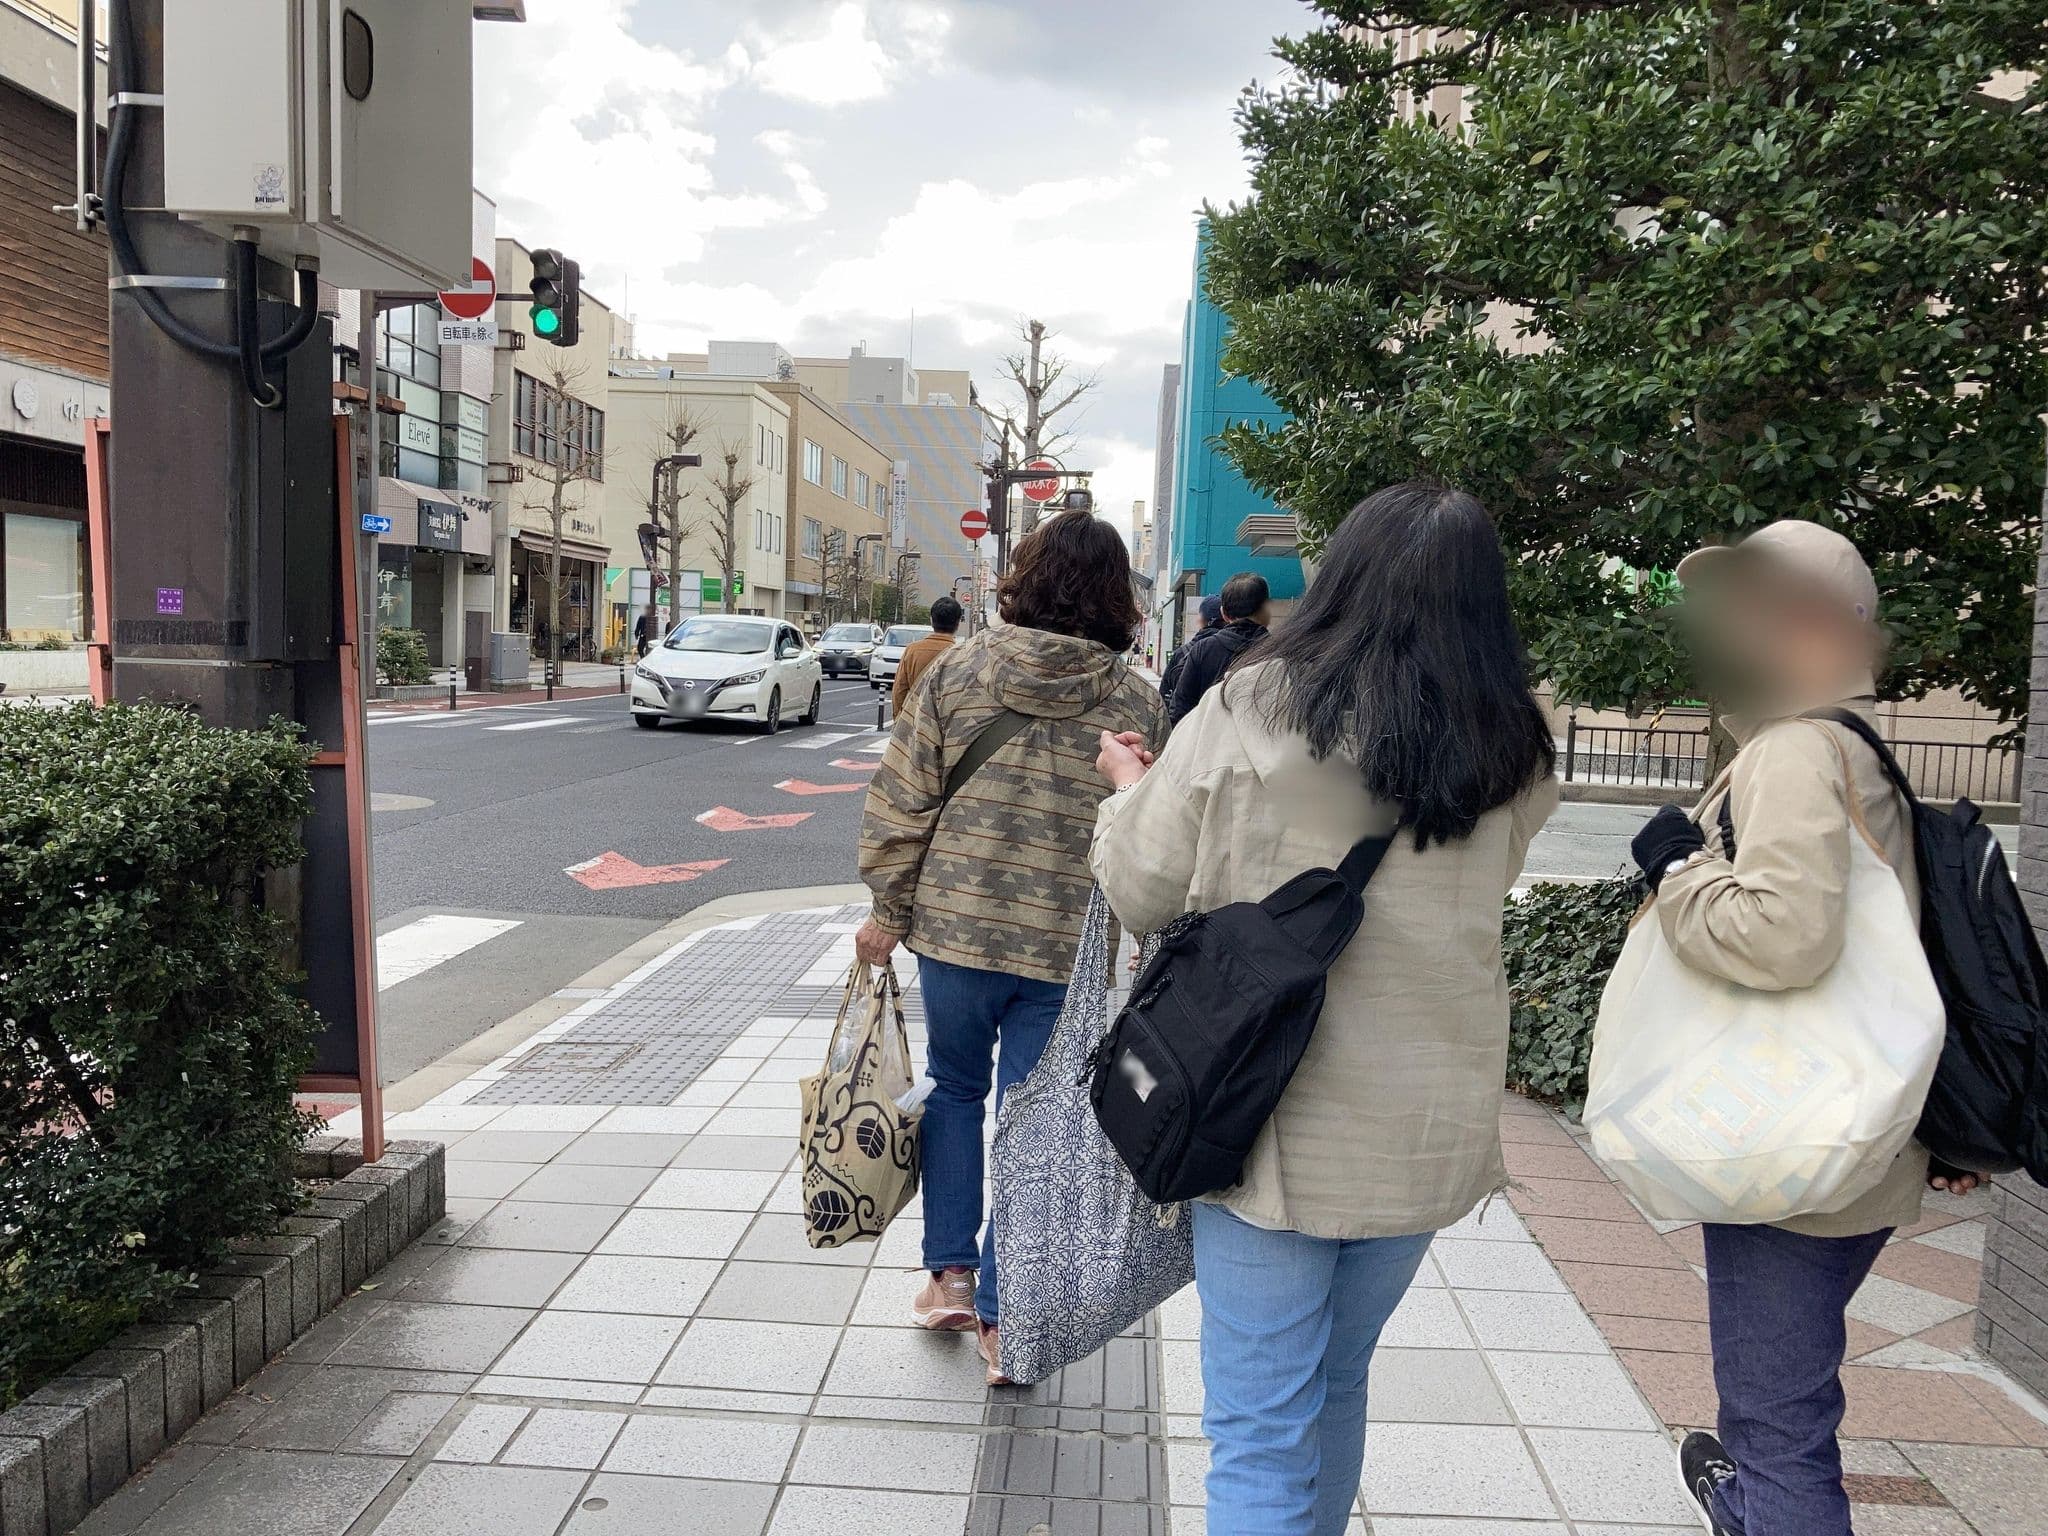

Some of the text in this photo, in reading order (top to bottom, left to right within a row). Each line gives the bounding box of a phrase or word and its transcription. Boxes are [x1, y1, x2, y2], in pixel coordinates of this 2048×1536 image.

[443, 326, 493, 340] 自転車を除く
[408, 418, 431, 445] Élevé
